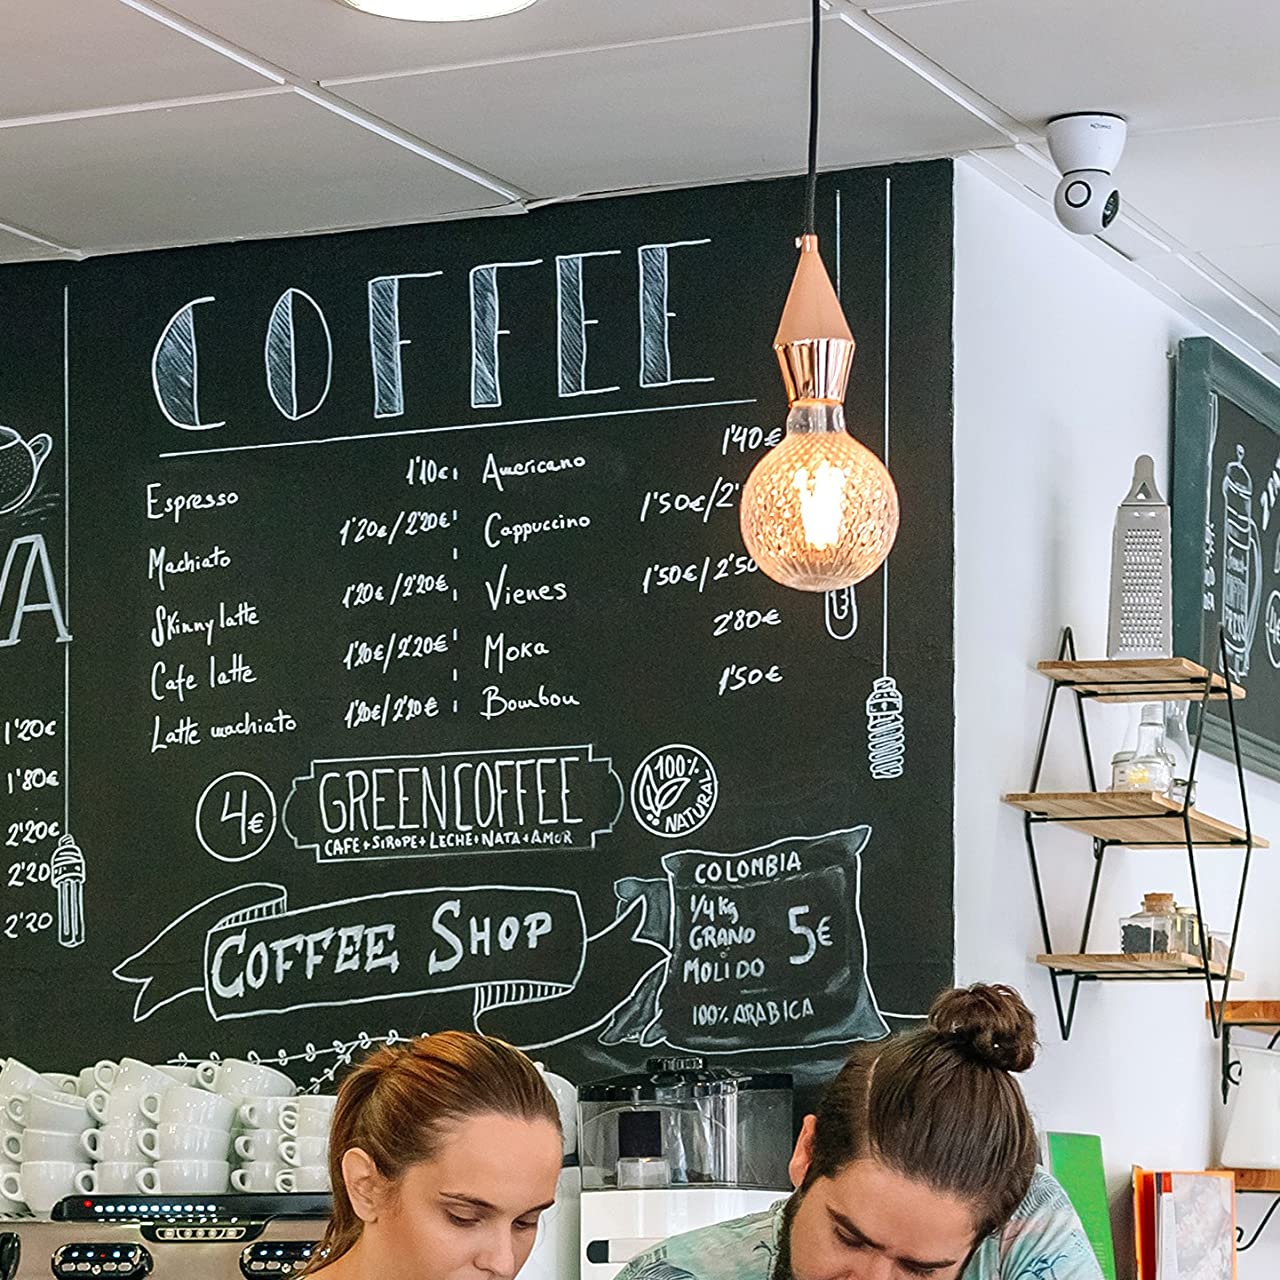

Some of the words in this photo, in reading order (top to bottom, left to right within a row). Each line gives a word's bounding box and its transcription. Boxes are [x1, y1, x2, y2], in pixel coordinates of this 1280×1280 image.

[152, 239, 715, 430] COFFEE
[482, 453, 586, 492] Americano
[146, 483, 239, 523] Espresso
[484, 512, 592, 548] Cappuccino
[148, 546, 231, 591] Machiato
[485, 563, 568, 611] Vienes
[151, 605, 214, 647] Skinny
[220, 602, 260, 629] latte
[485, 632, 550, 674] Moka
[151, 661, 197, 702] Cafe
[209, 653, 257, 688] latte
[151, 715, 201, 753] Latte
[211, 708, 297, 738] machiato
[665, 769, 715, 833] NATURAL
[694, 850, 802, 884] COLOMBIA
[211, 924, 400, 999] COFFEE
[428, 899, 553, 976] SHOP
[689, 925, 756, 951] GRANO
[733, 997, 814, 1028] ARABICA
